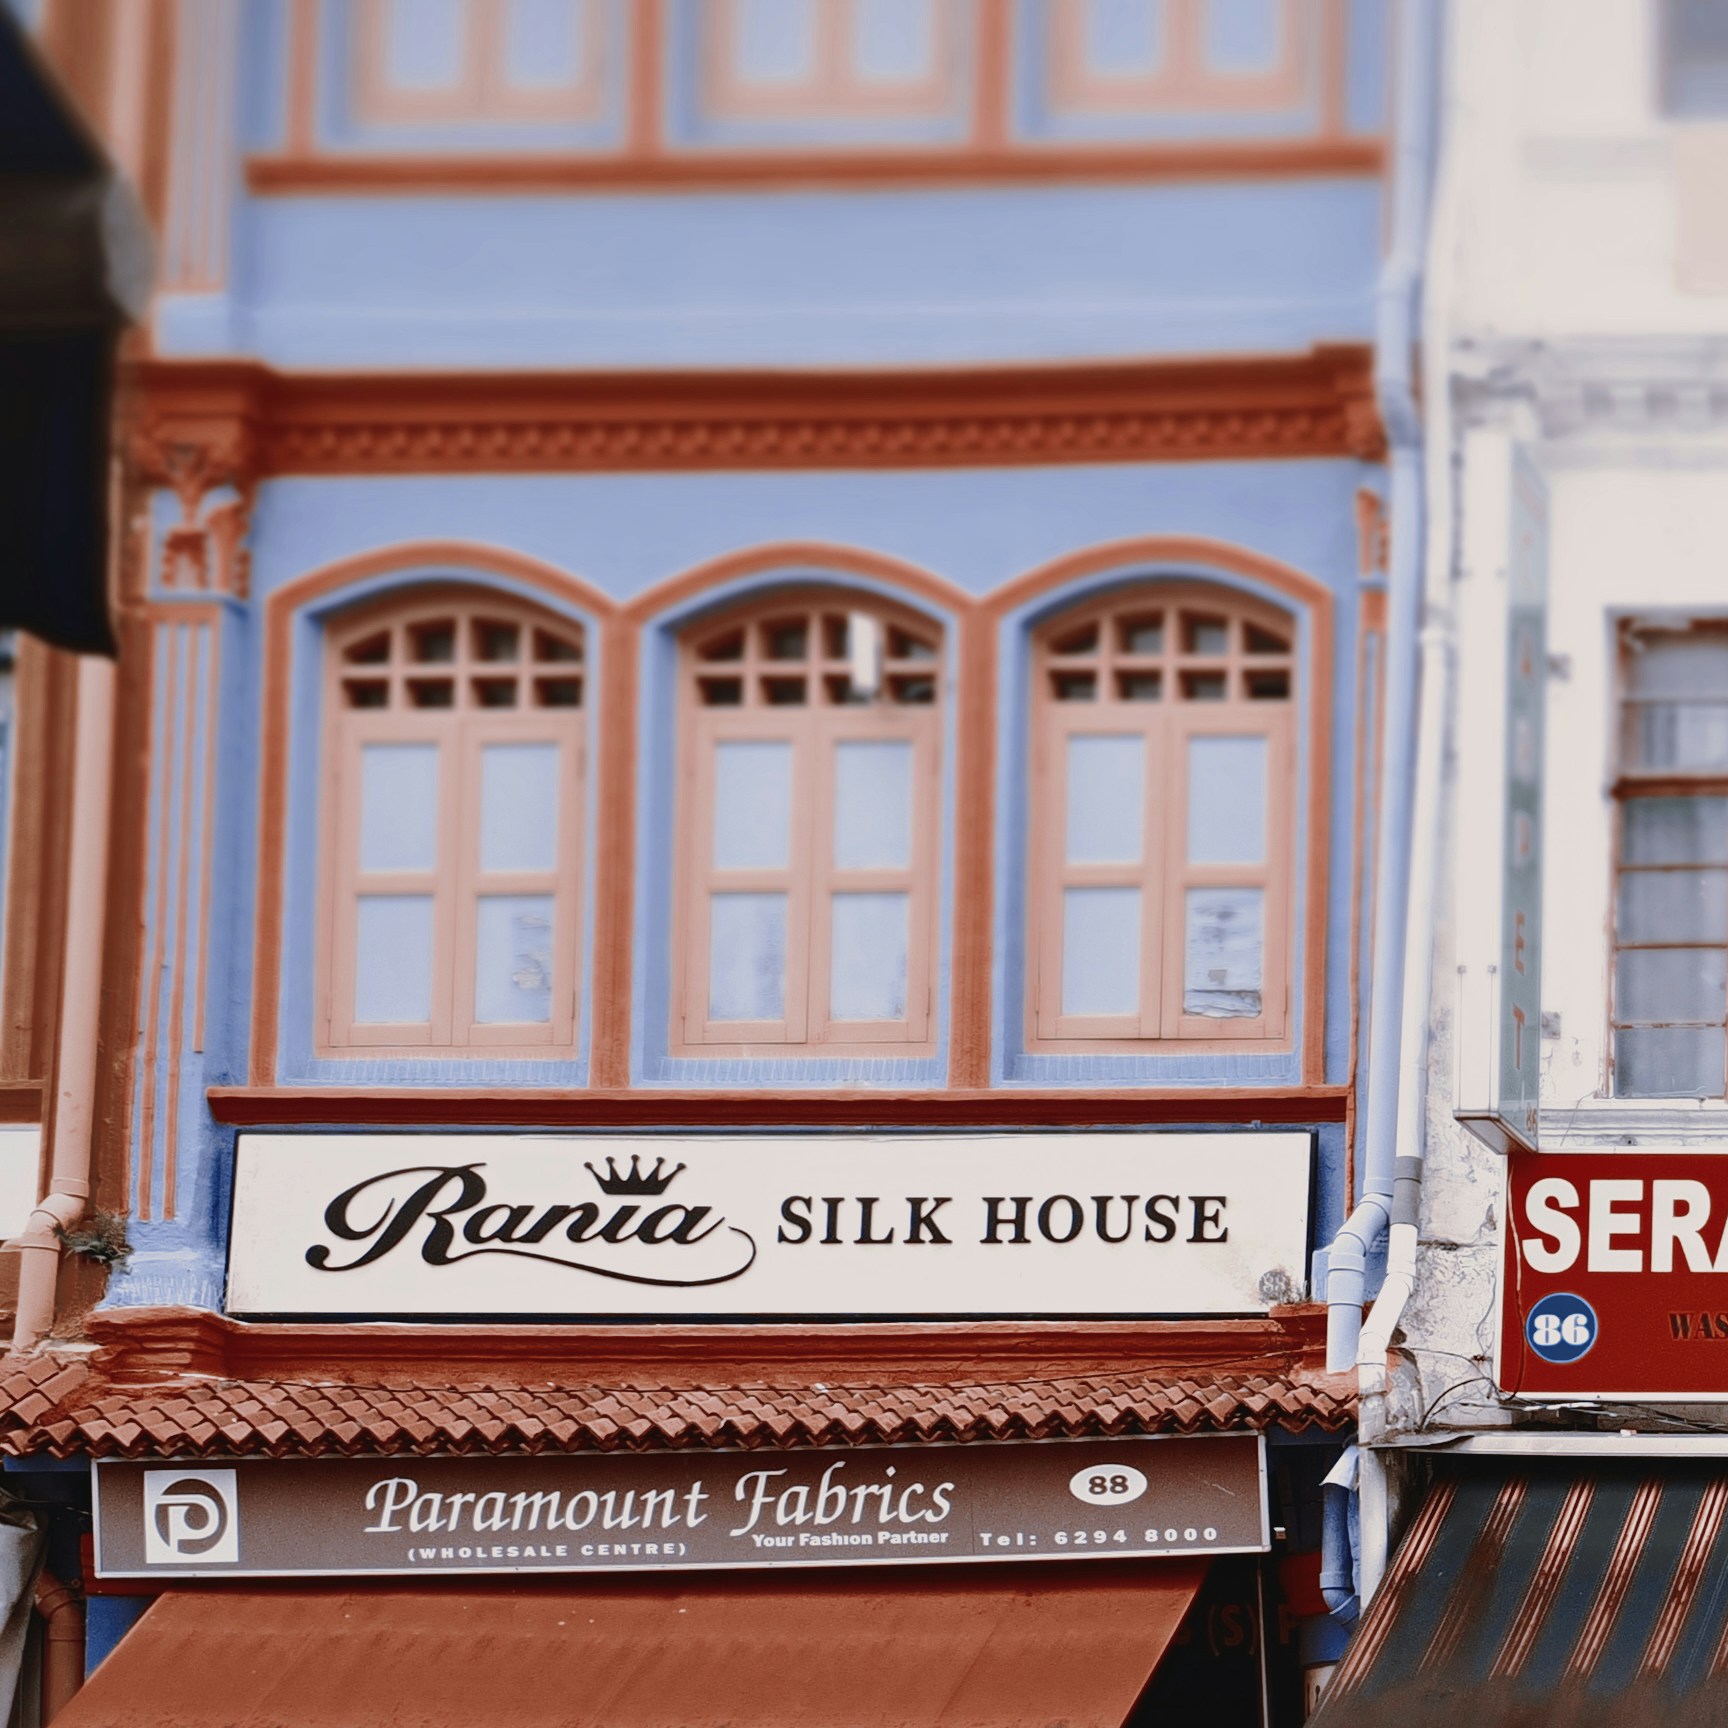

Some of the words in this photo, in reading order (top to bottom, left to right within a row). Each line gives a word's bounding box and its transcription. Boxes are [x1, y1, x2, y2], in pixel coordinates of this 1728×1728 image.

[304, 1162, 758, 1288] Rania
[777, 1195, 953, 1245] SILK
[979, 1194, 1229, 1245] HOUSE
[1533, 1313, 1591, 1349] 86
[1087, 1474, 1129, 1497] 88
[363, 1477, 711, 1534] Paramount
[728, 1461, 955, 1538] Fabrics
[751, 1533, 797, 1549] Your
[799, 1532, 873, 1547] Fashion
[877, 1530, 949, 1545] Partner
[979, 1532, 1037, 1547] Tel:
[1054, 1529, 1129, 1545] 6294
[1144, 1527, 1218, 1543] 8000
[407, 1545, 569, 1562] (WHOLESALE
[580, 1542, 687, 1558] CENTRE)
